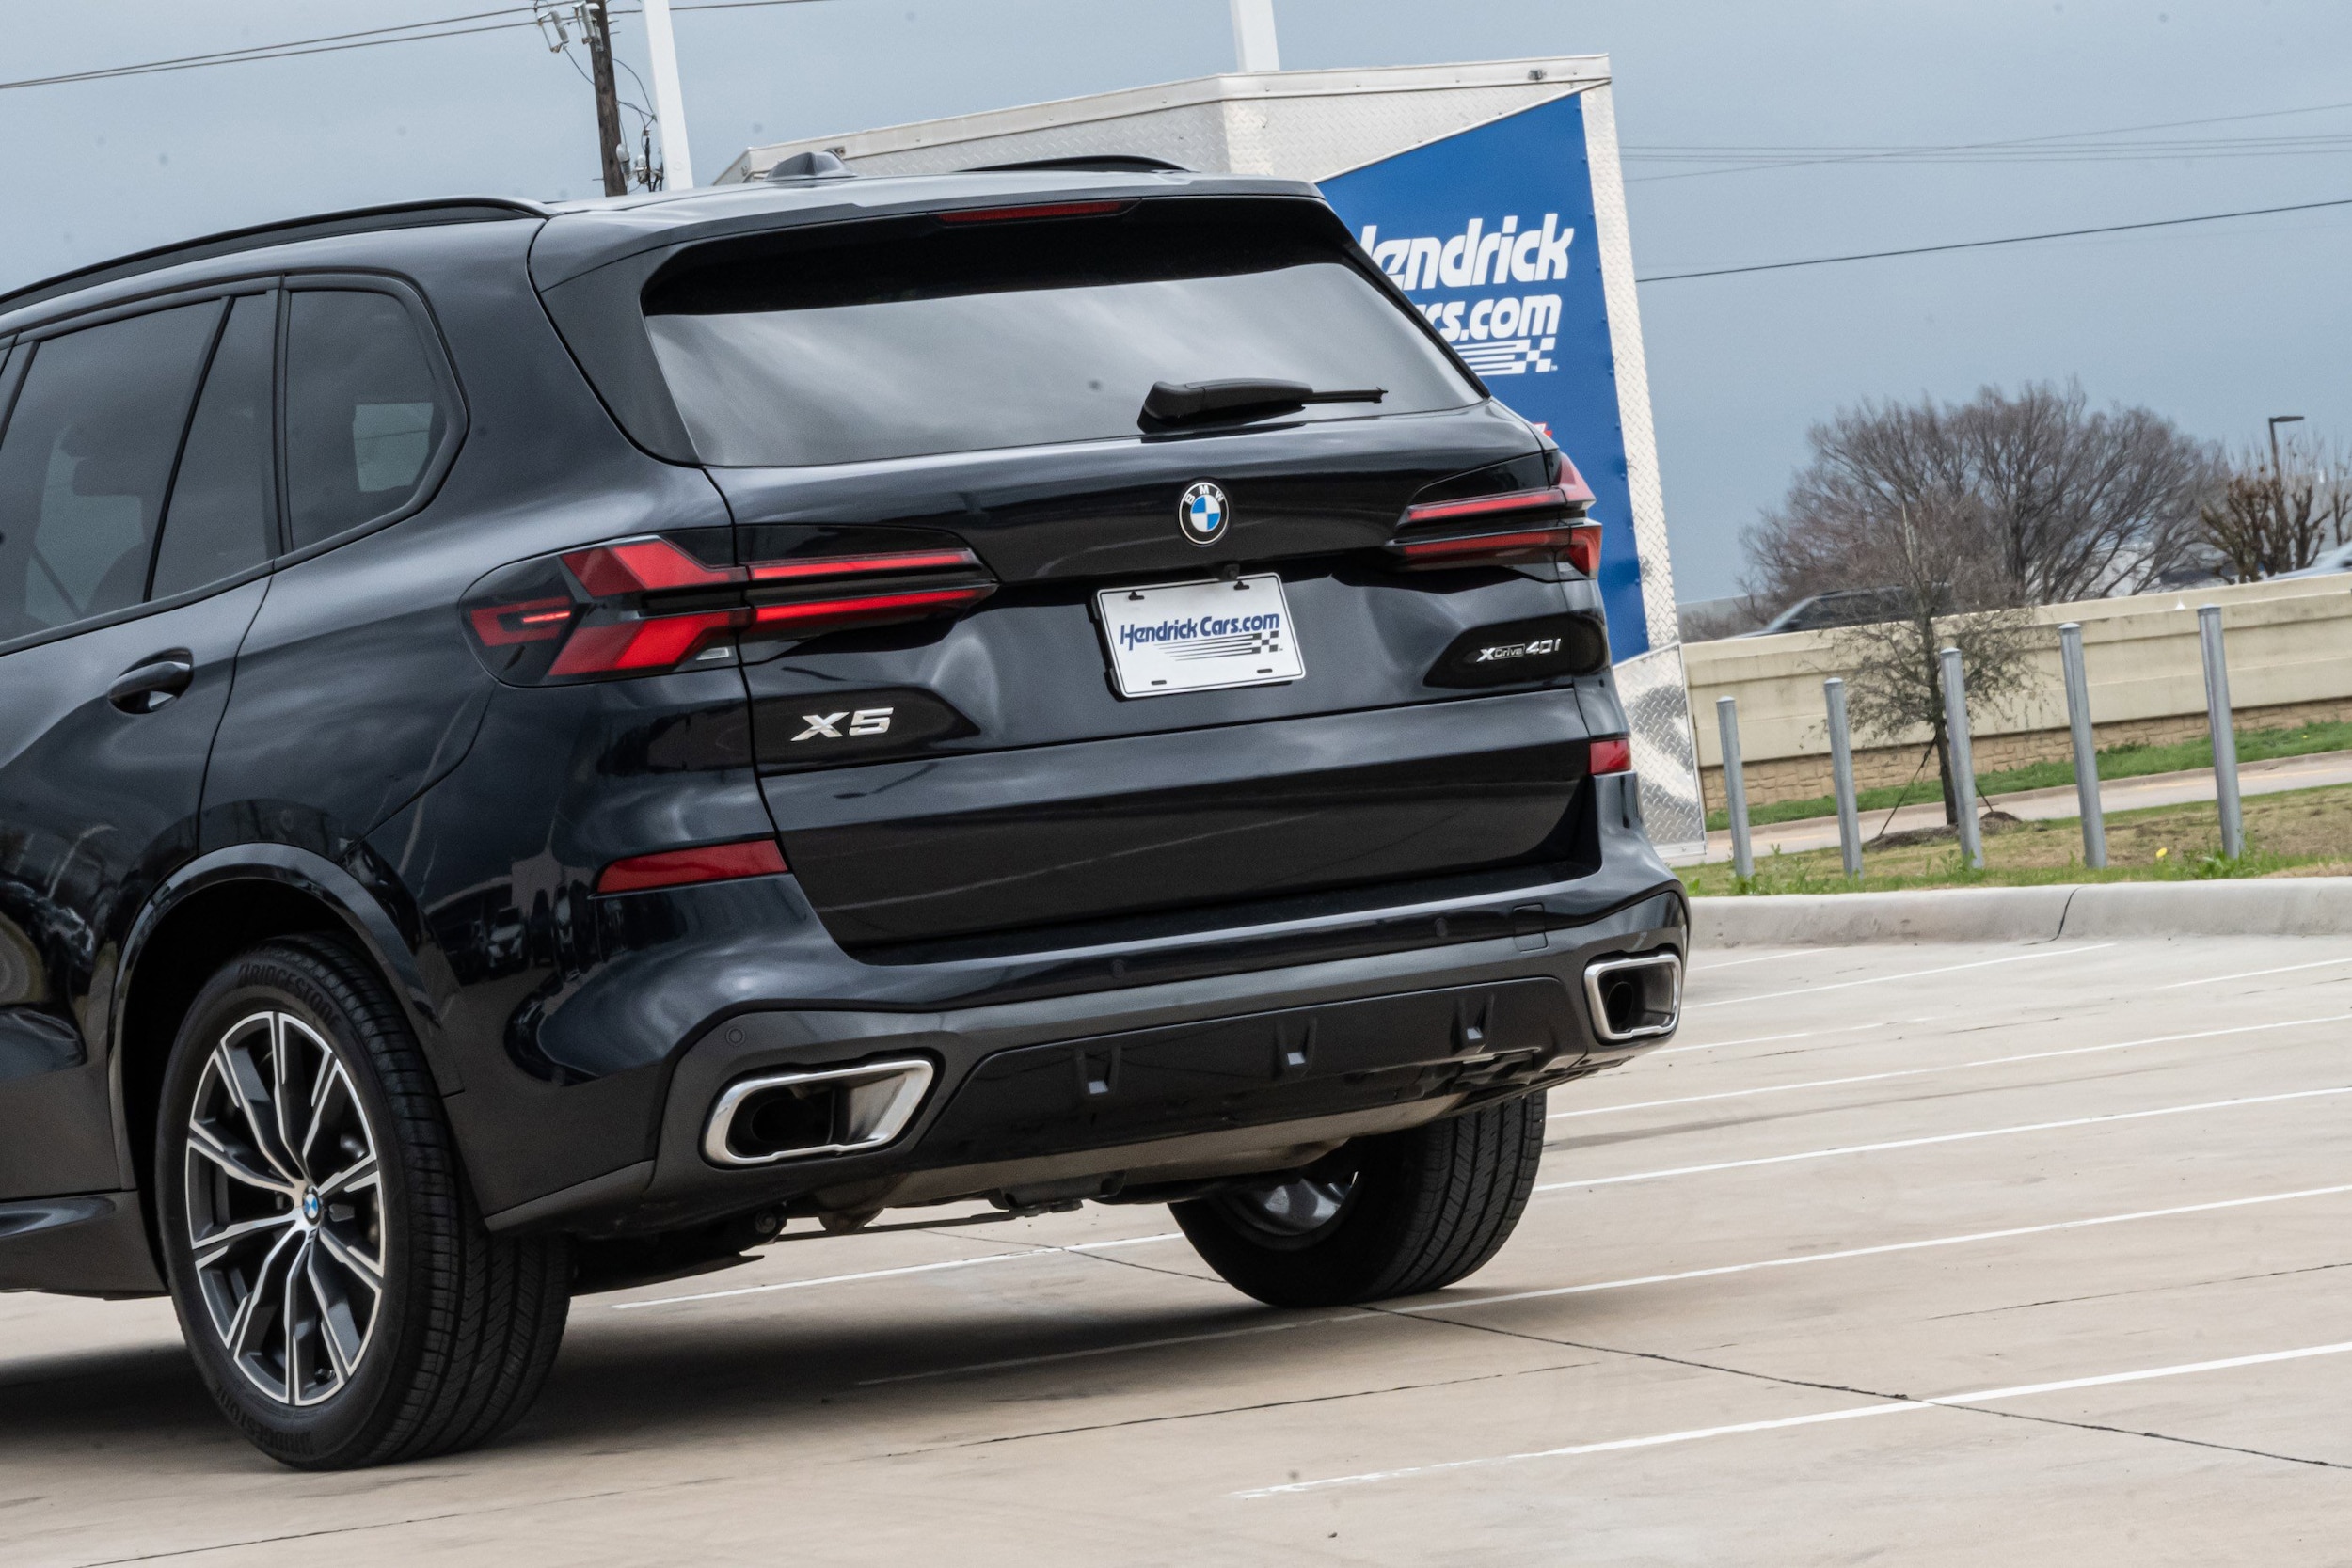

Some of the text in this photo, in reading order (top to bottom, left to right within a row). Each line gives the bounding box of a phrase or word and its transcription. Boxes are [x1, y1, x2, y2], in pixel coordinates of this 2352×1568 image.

[1415, 294, 1562, 341] rs.com
[1184, 484, 1225, 506] BMW
[790, 707, 894, 741] X5
